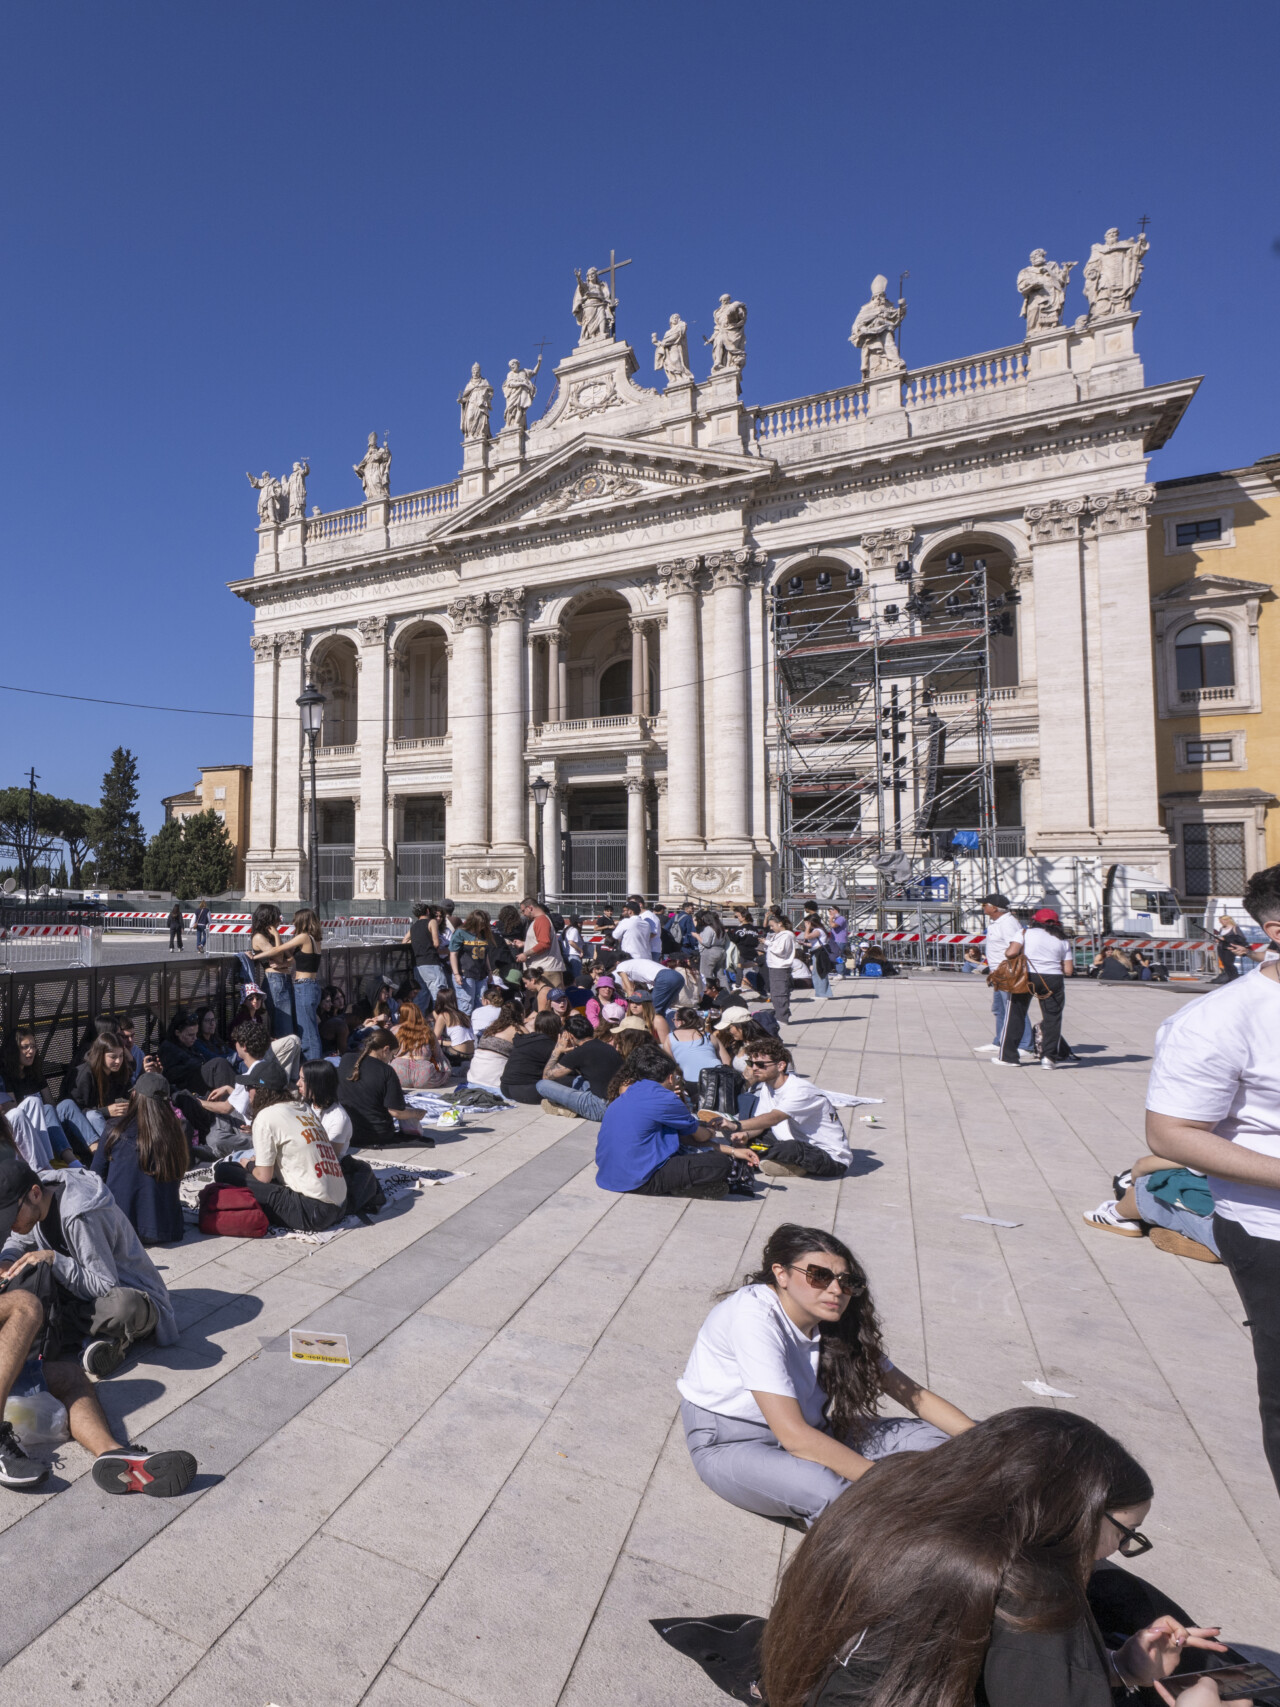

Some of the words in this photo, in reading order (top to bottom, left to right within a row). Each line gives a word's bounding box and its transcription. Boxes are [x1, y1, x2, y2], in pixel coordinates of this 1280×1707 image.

[749, 513, 767, 526] IN
[779, 503, 822, 524] HON
[832, 499, 852, 511] SS
[863, 483, 917, 505] IOAN
[930, 472, 985, 493] BAPT
[1001, 464, 1025, 480] ET
[1040, 444, 1131, 472] EVANG
[483, 543, 572, 570] CHRISTO
[583, 516, 715, 549] SALVATORI
[259, 601, 309, 617] CLEMENS
[312, 597, 329, 609] XII
[333, 589, 366, 603] PONT
[372, 584, 401, 596] MAX
[407, 573, 447, 589] ANNO
[316, 1144, 336, 1160] THE
